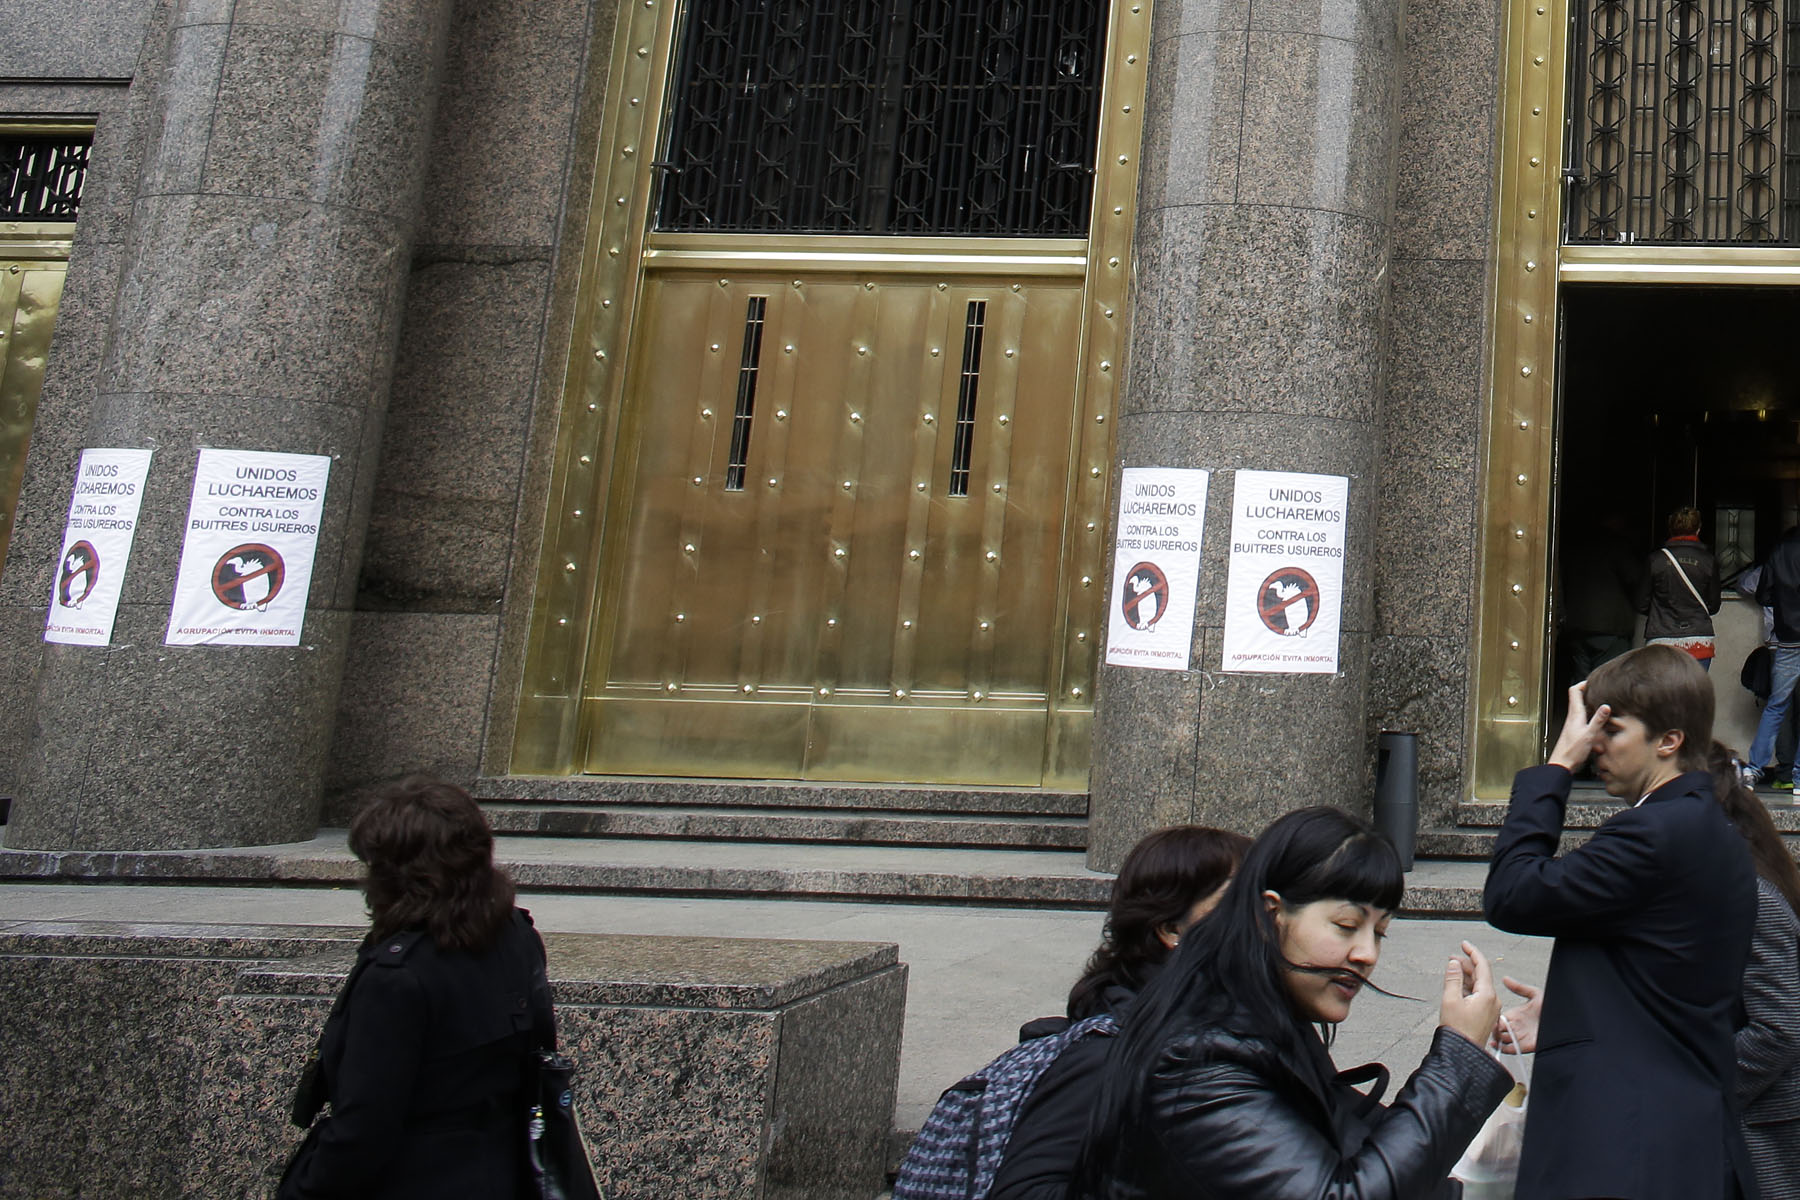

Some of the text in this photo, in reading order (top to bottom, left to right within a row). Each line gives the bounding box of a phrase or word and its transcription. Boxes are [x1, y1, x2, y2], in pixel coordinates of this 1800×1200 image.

[85, 464, 119, 477] UNIDOS
[236, 467, 297, 481] UNIDOS
[208, 483, 318, 500] LUCHAREMOS
[1135, 484, 1176, 497] UNIDOS
[1269, 488, 1322, 503] UNIDOS
[98, 505, 117, 516] LOS
[219, 506, 299, 520] CONTRA LOS
[1123, 502, 1197, 516] LUCHAREMOS
[1246, 505, 1341, 522] LUCHAREMOS
[83, 519, 133, 531] USUREROS
[191, 520, 317, 534] BUITRES USUREROS
[1126, 525, 1179, 536] CONTRA LOS
[1257, 530, 1327, 543] CONTRA LOS
[1116, 539, 1198, 552] BUITRES USUREROS
[1234, 543, 1343, 558] BUITRES USUREROS
[1303, 655, 1334, 663] INMORTAL
